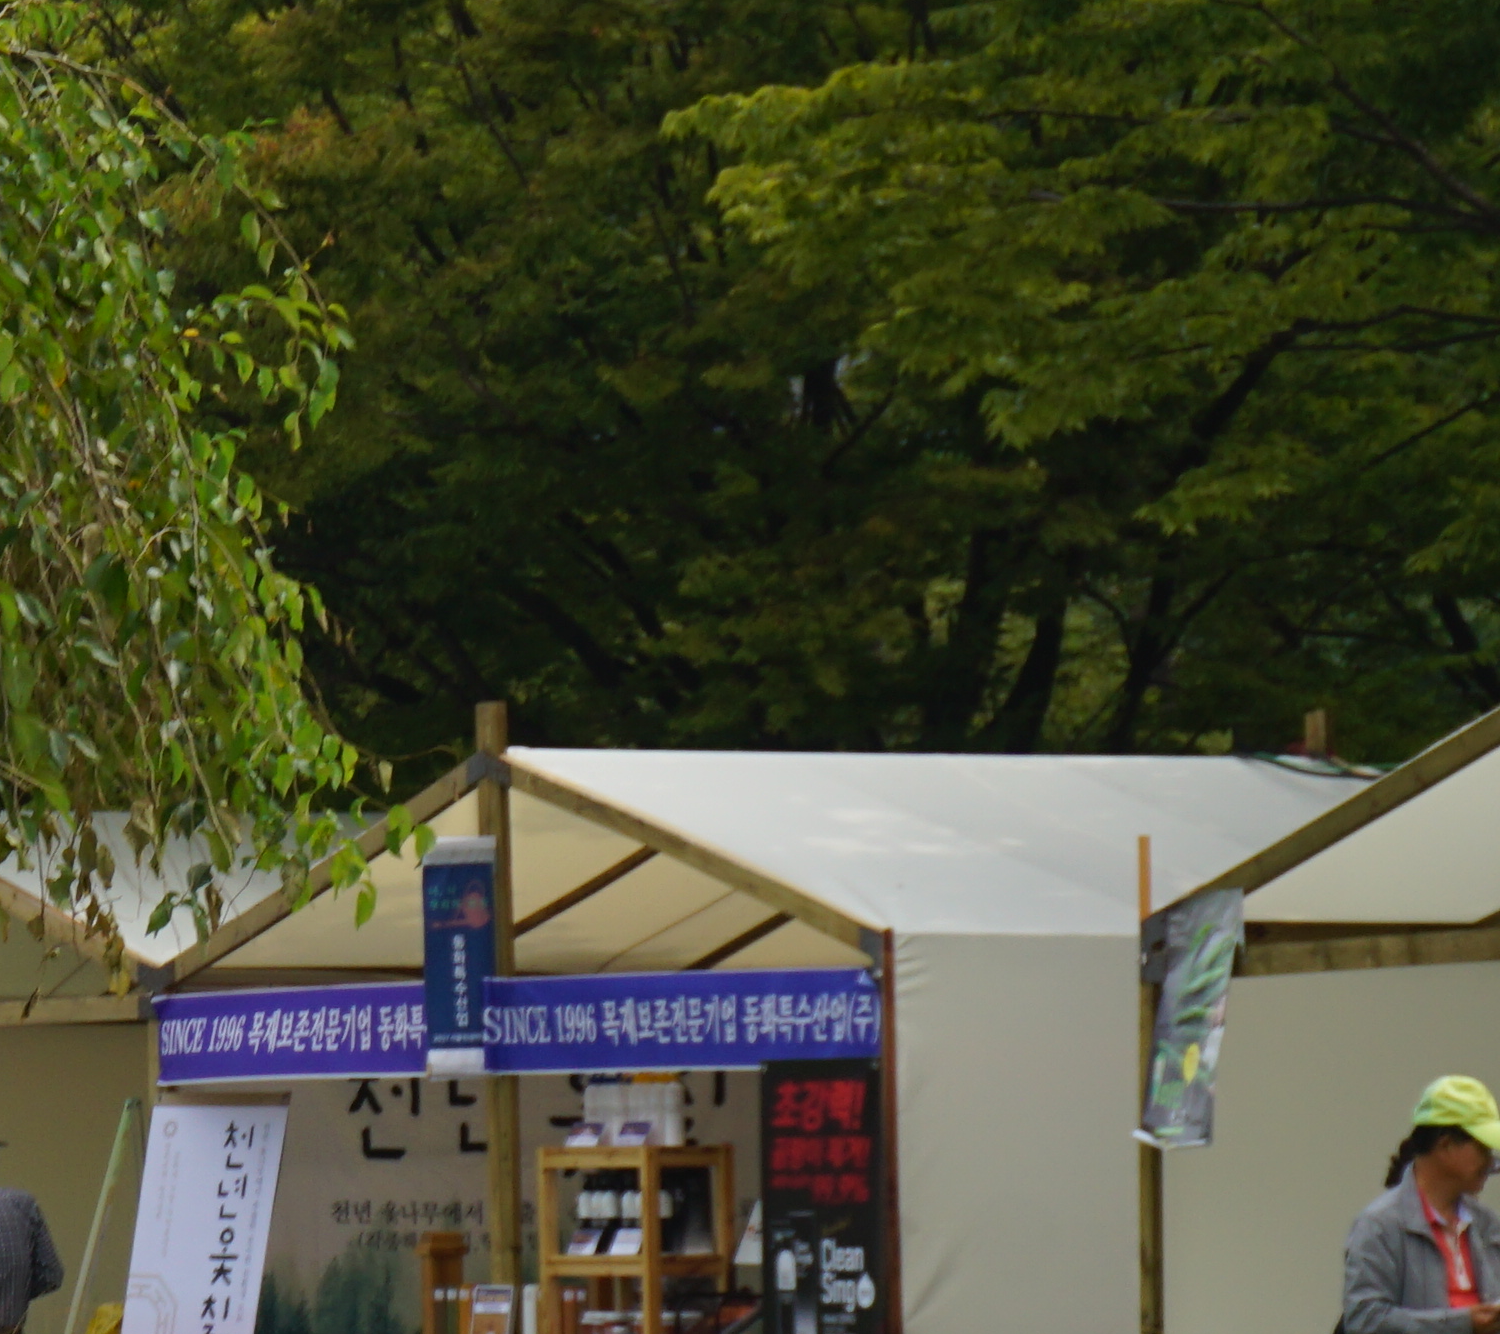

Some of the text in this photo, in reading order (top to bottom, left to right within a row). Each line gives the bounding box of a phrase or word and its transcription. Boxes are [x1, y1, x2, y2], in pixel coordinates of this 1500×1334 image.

[161, 1017, 205, 1055] SINCE
[207, 1014, 247, 1052] 1996
[248, 1005, 372, 1054] 목재보존전문기업
[483, 992, 881, 1046] SINCE 1996 목재보존전문기업 동화특수산업(주)
